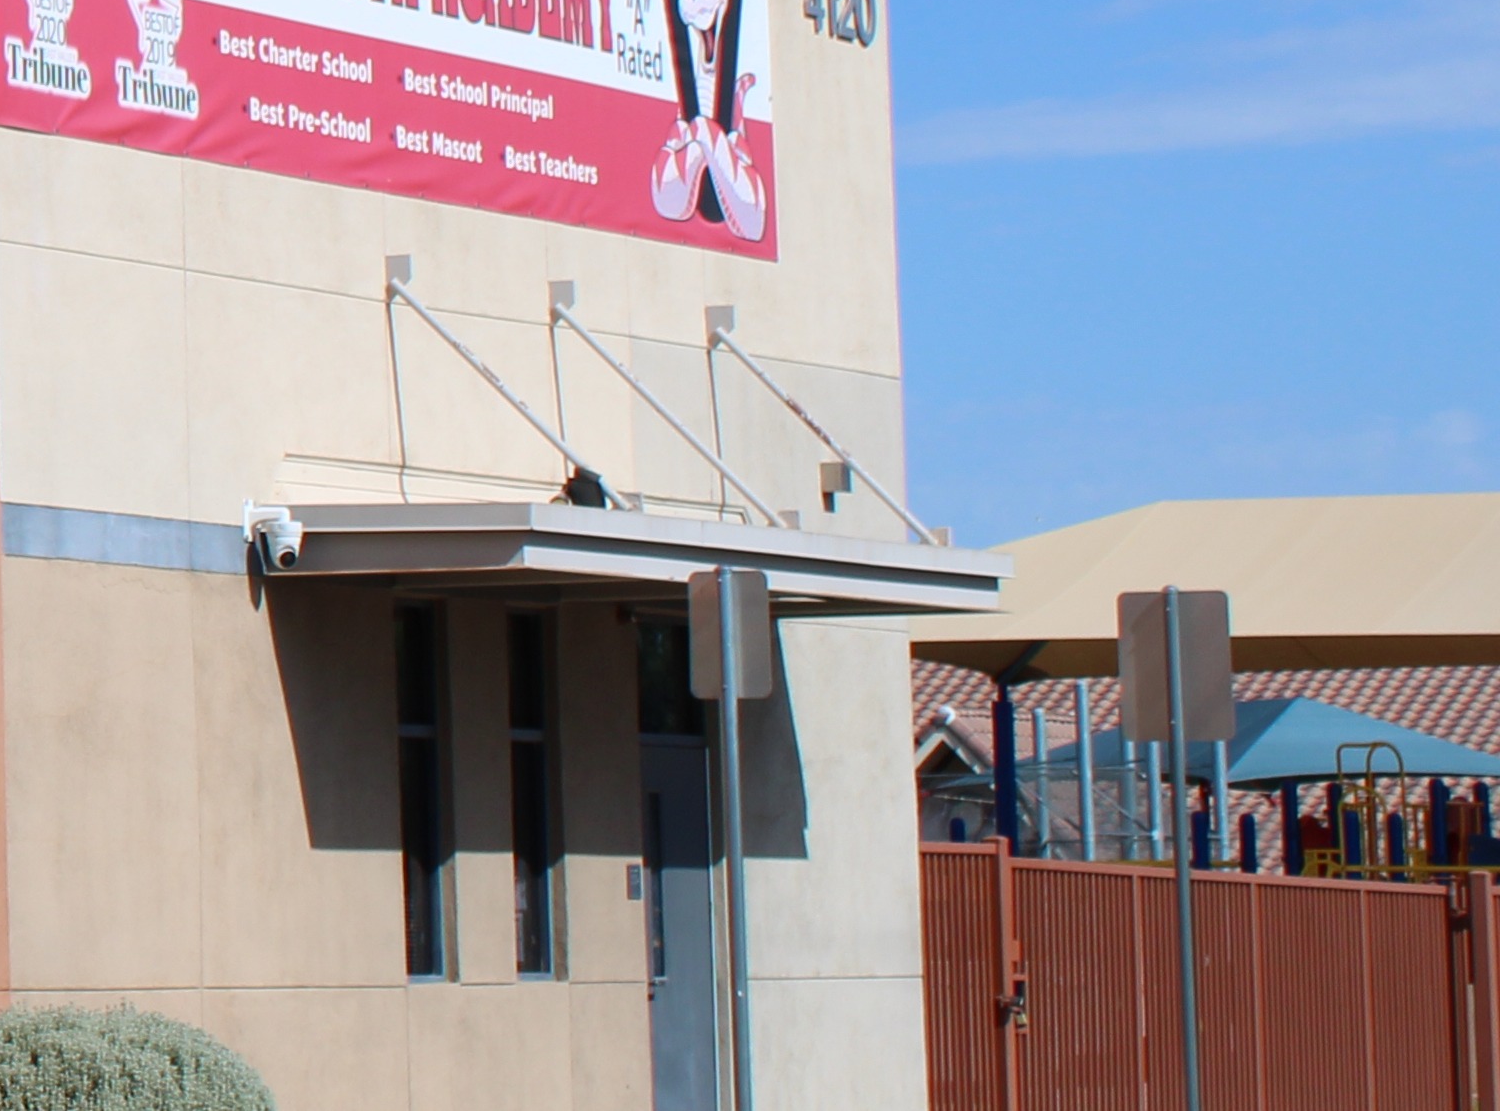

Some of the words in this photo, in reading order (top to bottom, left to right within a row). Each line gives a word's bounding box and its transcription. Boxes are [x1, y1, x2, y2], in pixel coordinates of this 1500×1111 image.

[36, 14, 67, 47] 2020
[146, 36, 176, 67] 2019
[7, 43, 88, 94] Tribune
[219, 29, 255, 60] Best
[259, 39, 318, 73] Charter
[322, 52, 373, 84] School
[616, 33, 663, 82] Rated
[118, 65, 196, 114] Tribune
[404, 67, 437, 97] Best
[440, 75, 488, 107] School
[491, 84, 554, 123] Principal
[249, 96, 285, 127] Best
[288, 103, 372, 143] Pre-School
[396, 125, 429, 155] Best
[432, 132, 483, 164] Mascot
[505, 145, 536, 174] Best
[539, 152, 599, 186] Teachers
